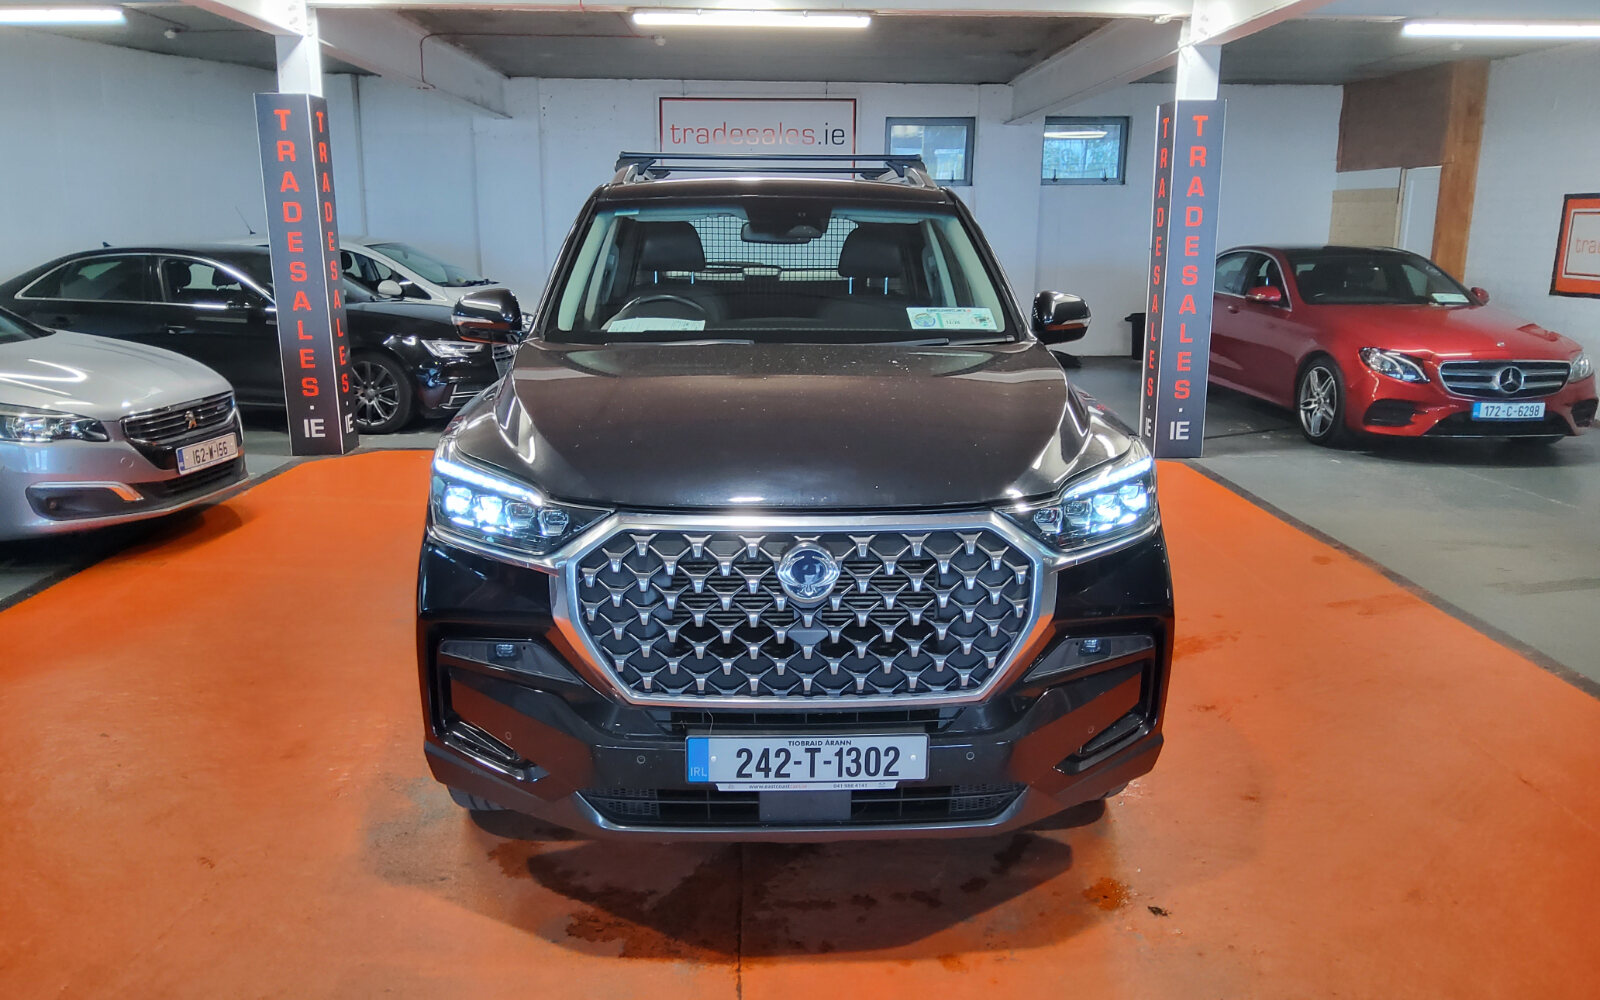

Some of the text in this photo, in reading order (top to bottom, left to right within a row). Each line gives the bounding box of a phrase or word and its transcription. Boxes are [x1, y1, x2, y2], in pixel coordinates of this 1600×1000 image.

[670, 122, 845, 145] tradesales.ie
[1575, 237, 1600, 254] tra
[1484, 405, 1540, 417] 172-C-6298
[825, 738, 852, 746] ÁRANN
[736, 746, 901, 779] 242-T-1302
[690, 766, 708, 777] IRL
